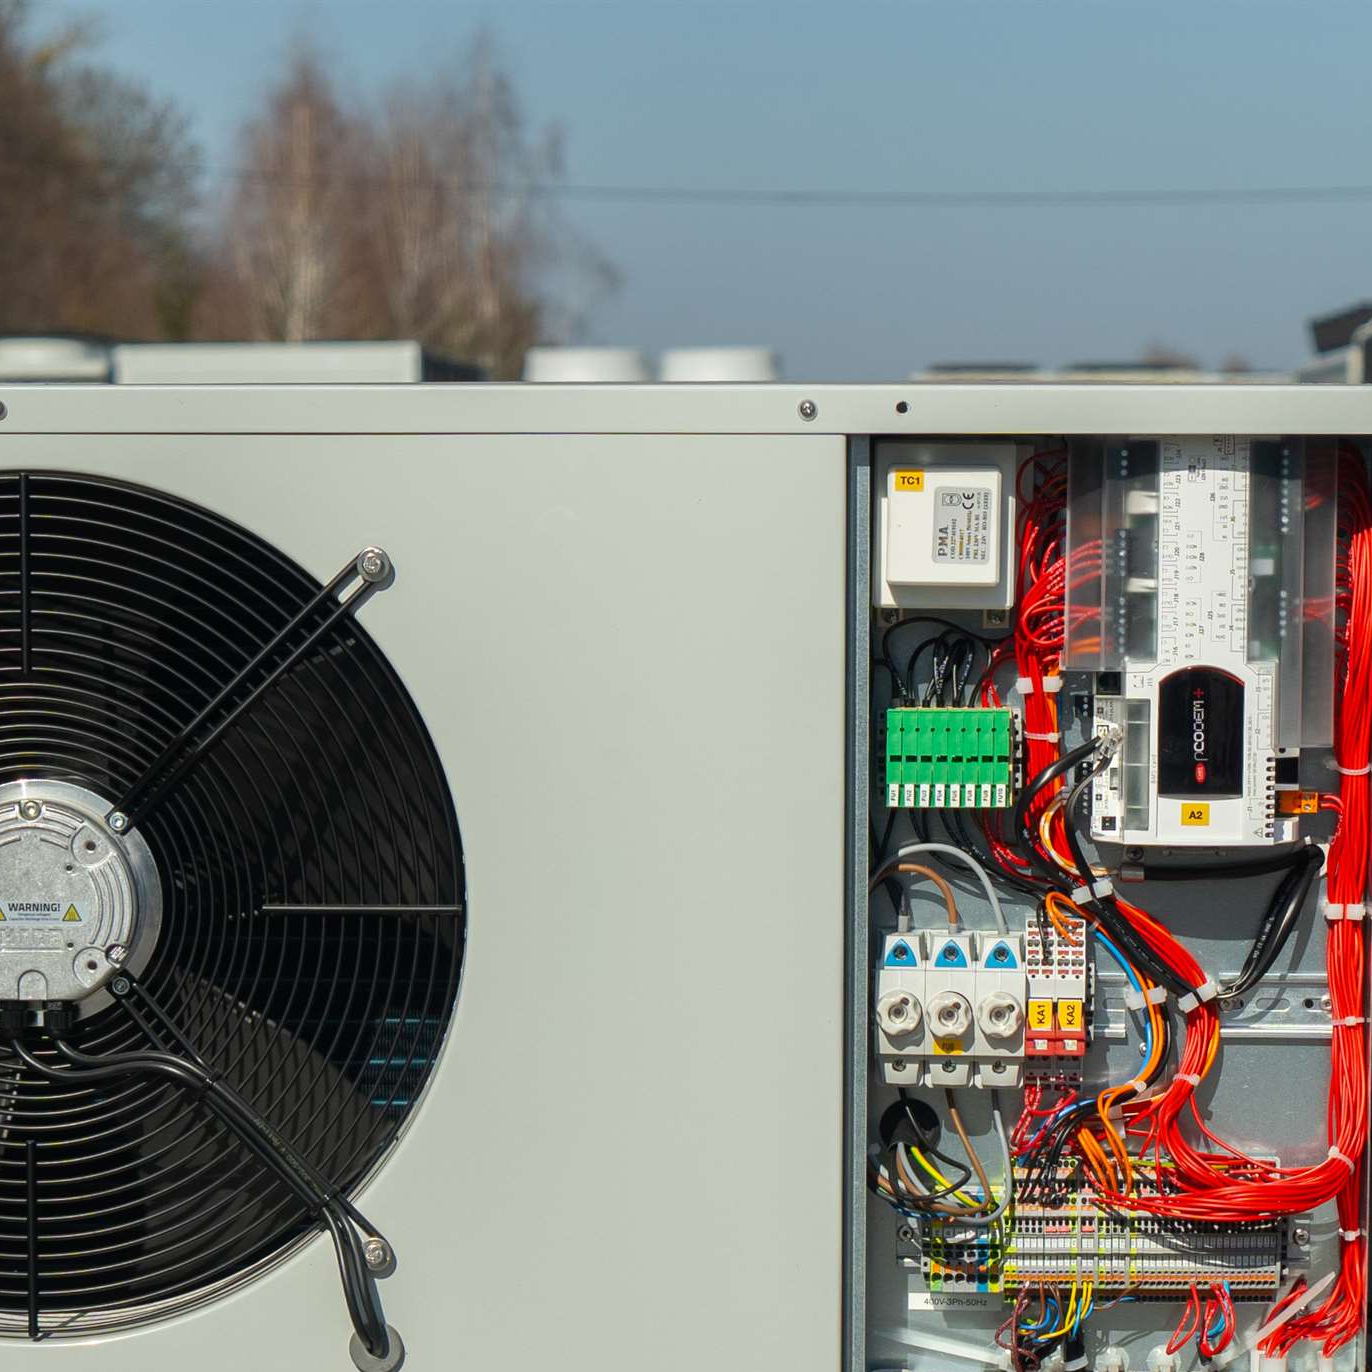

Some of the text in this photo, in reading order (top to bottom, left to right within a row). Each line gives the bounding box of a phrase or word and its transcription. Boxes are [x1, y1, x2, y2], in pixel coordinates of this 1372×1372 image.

[899, 475, 921, 486] TC1
[1188, 811, 1203, 820] A2
[8, 902, 61, 912] WARNING!
[1037, 1004, 1045, 1024] KA1
[1066, 1004, 1075, 1025] KA2
